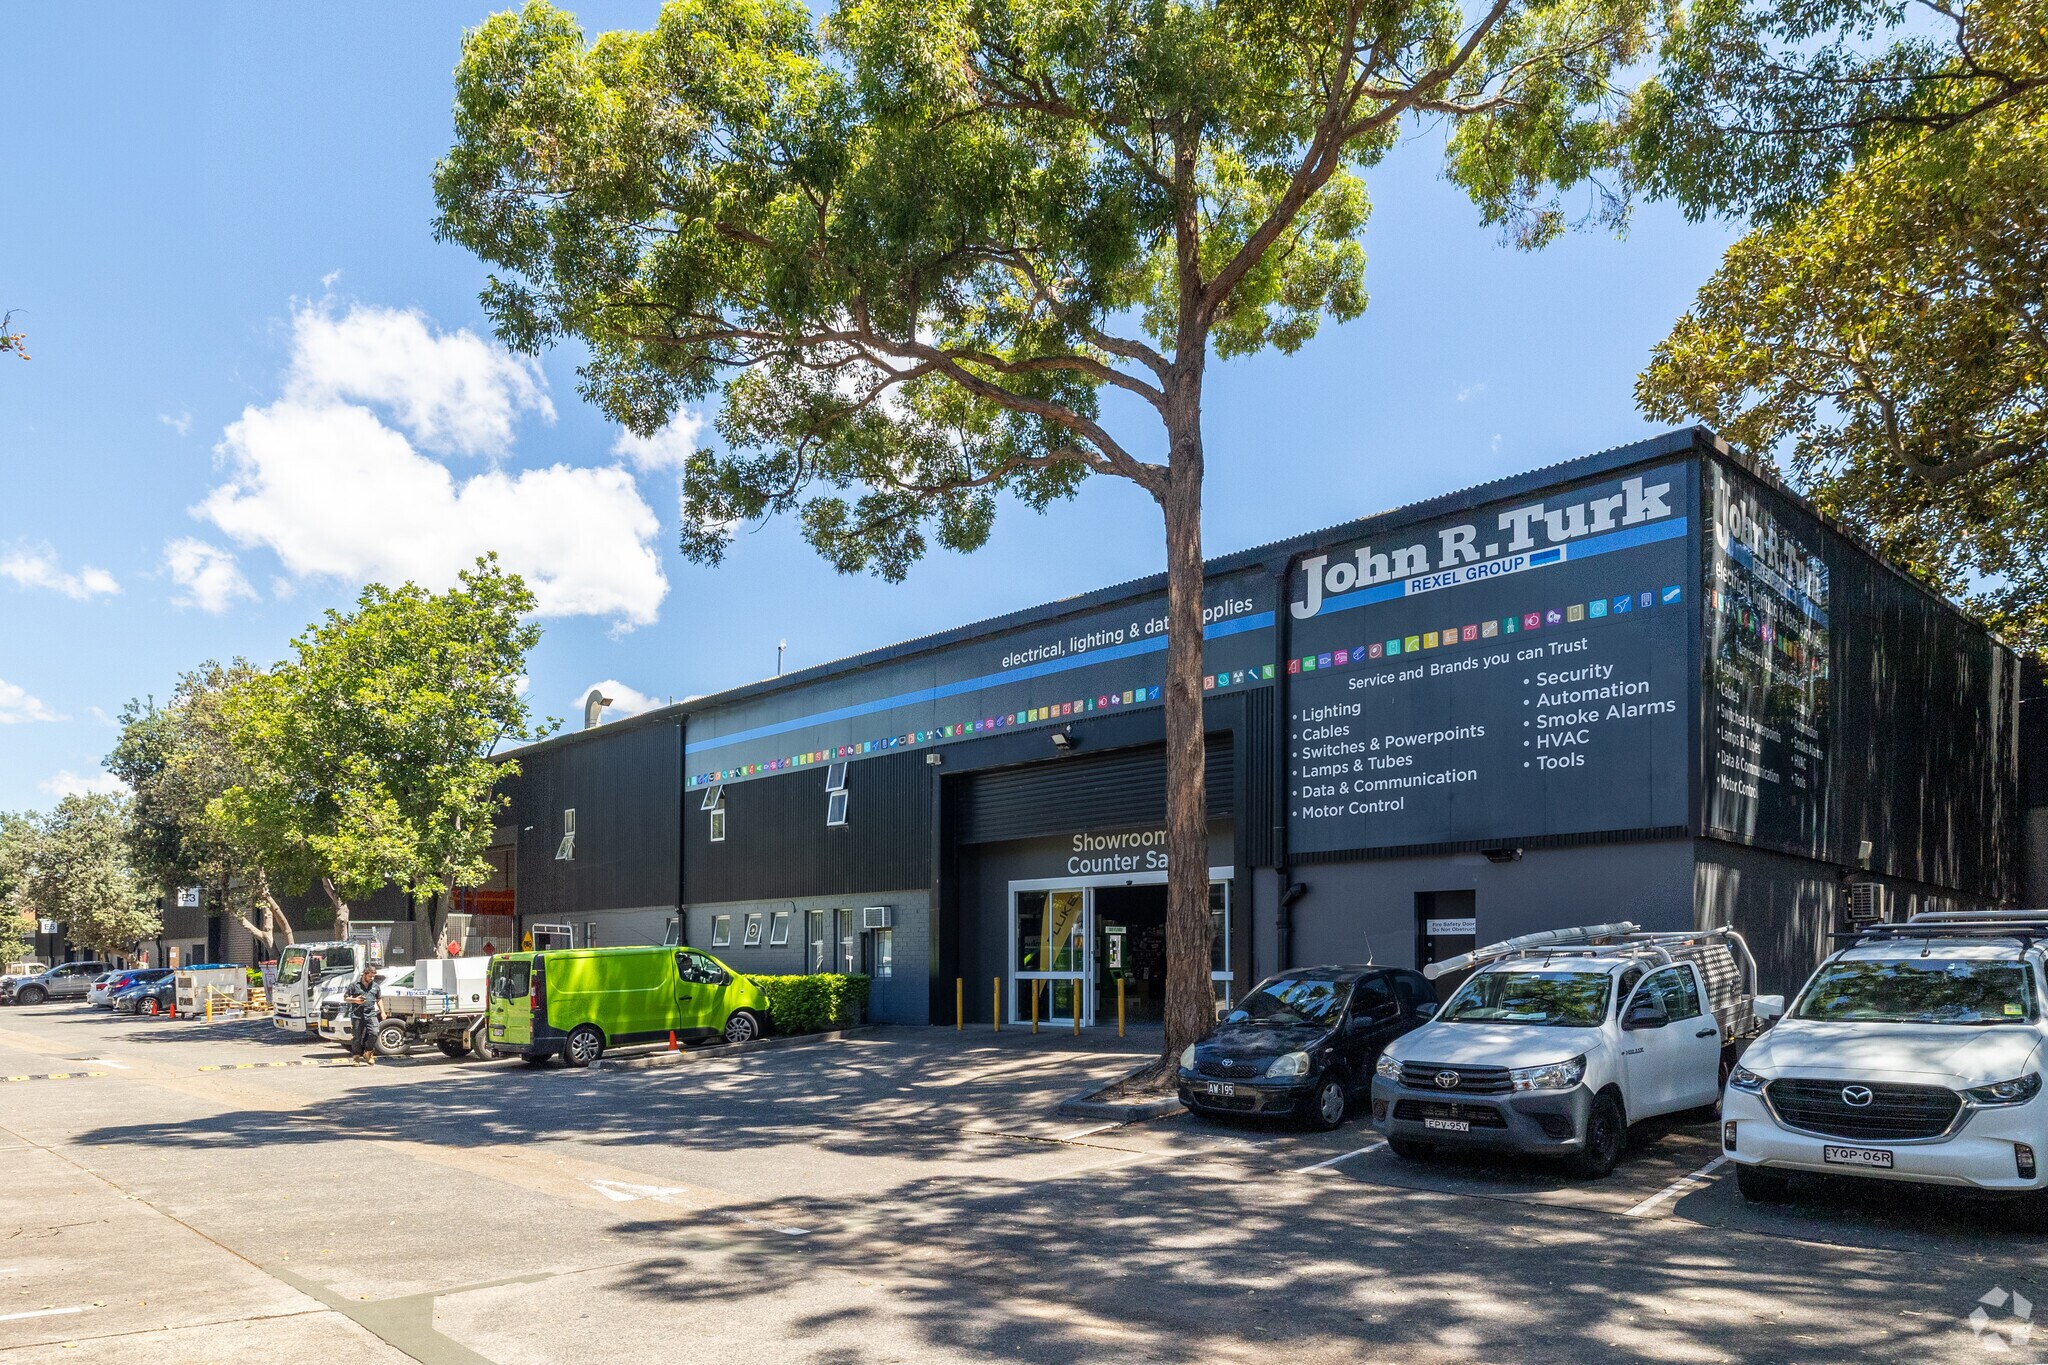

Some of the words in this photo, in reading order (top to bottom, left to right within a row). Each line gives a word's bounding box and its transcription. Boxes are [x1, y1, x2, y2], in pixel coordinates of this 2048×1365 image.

[1290, 543, 1430, 620] John
[1411, 571, 1461, 593] REXEL
[1465, 556, 1525, 581] GROUP
[1002, 640, 1065, 668] electrical,
[1070, 629, 1124, 653] lighting
[1129, 622, 1140, 638] &
[1144, 616, 1169, 634] dat
[1202, 598, 1253, 624] pplies
[1348, 673, 1395, 690] Service
[1399, 666, 1424, 681] and
[1430, 657, 1479, 676] Brands
[1483, 653, 1510, 669] you
[1516, 647, 1543, 661] can
[1548, 637, 1588, 656] Trust
[1536, 664, 1613, 687] Security
[1536, 680, 1649, 708] Automation
[1302, 703, 1361, 723] Lighting
[1536, 709, 1600, 729] Smoke
[1605, 699, 1676, 720] Alarms
[1302, 724, 1350, 742] Cables
[1302, 742, 1366, 760] Switches
[1370, 738, 1381, 751] &
[1385, 724, 1486, 749] Powerpoints
[1537, 729, 1590, 749] HVAC
[1302, 762, 1349, 778] Lamps
[1353, 759, 1364, 772] &
[1368, 754, 1413, 771] Tubes
[1536, 752, 1585, 770] Tools
[1302, 784, 1335, 799] Data
[1339, 781, 1350, 795] &
[1354, 768, 1477, 793] Communication
[1721, 773, 1738, 794] Motor
[1302, 804, 1345, 819] Motor
[1348, 797, 1404, 814] Control
[1067, 853, 1140, 874] Counter
[182, 894, 196, 902] E3
[1046, 894, 1080, 943] LUKE
